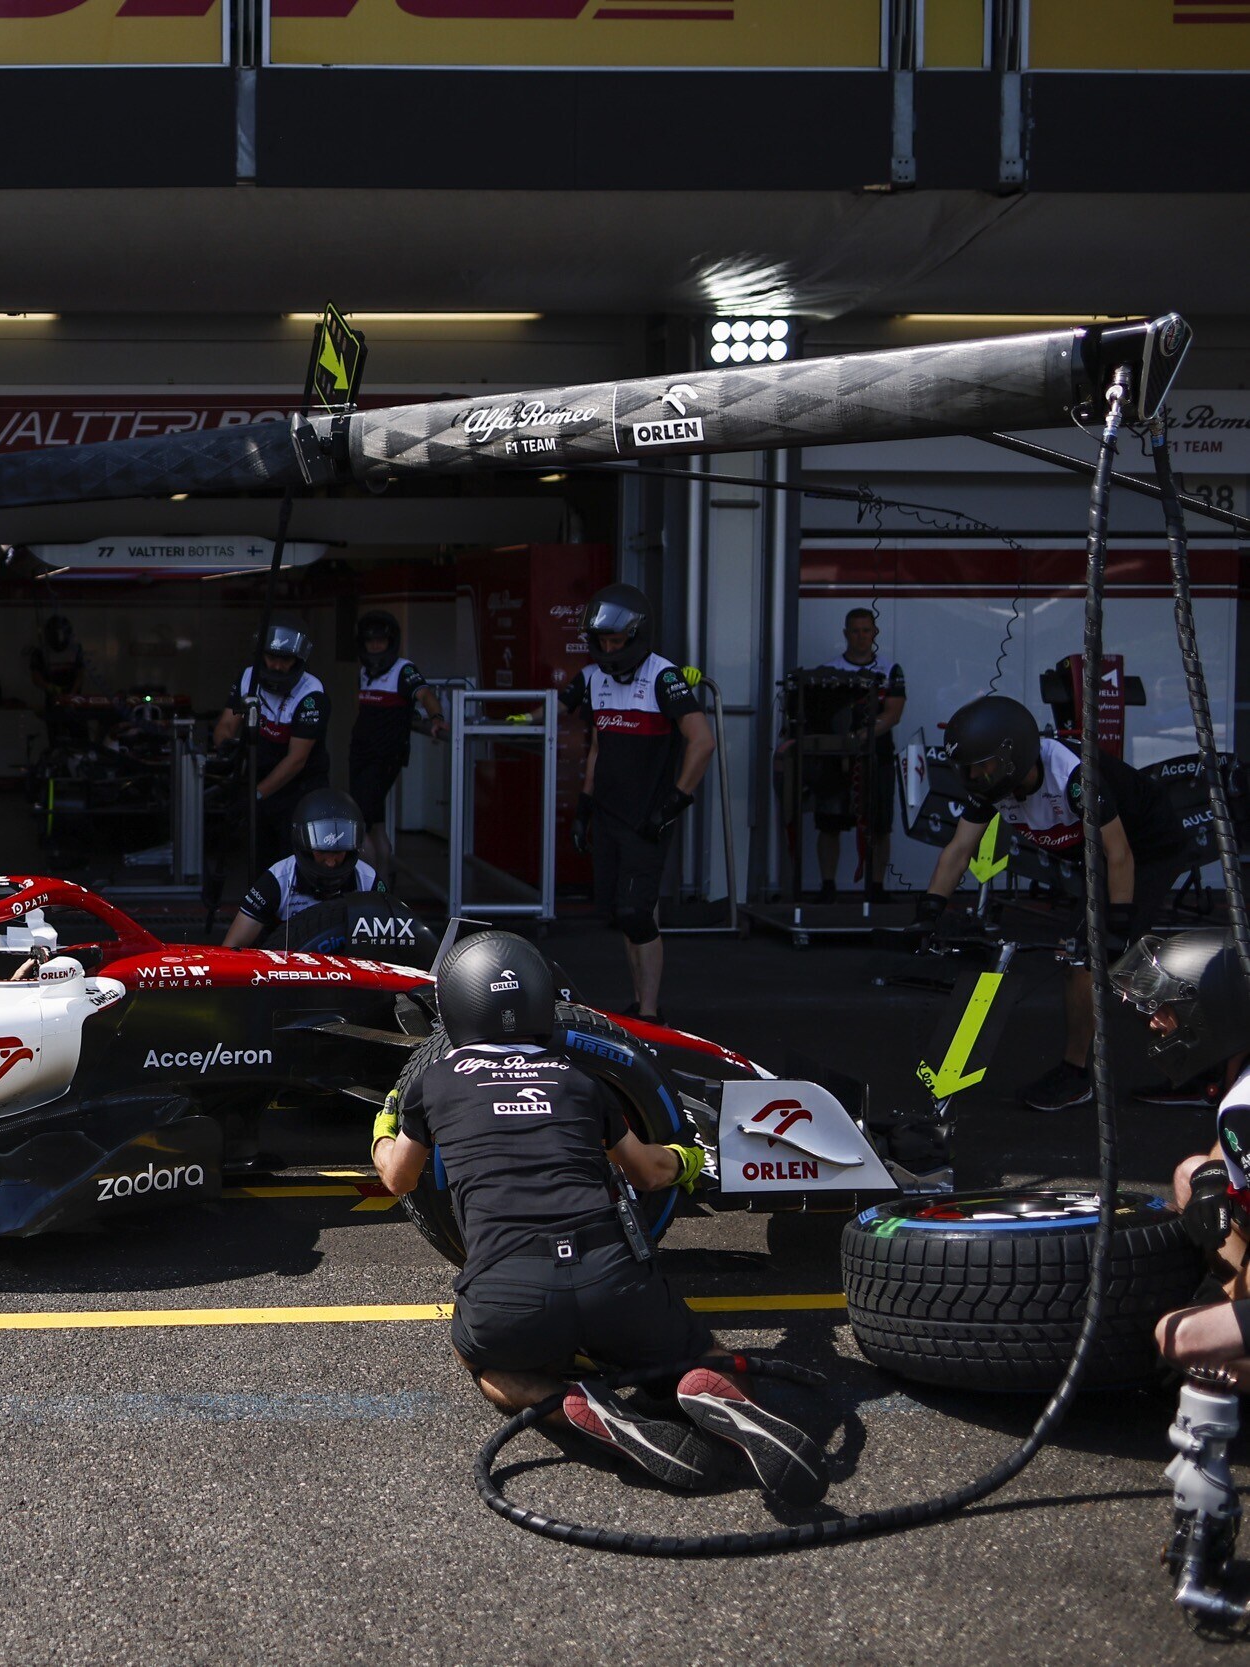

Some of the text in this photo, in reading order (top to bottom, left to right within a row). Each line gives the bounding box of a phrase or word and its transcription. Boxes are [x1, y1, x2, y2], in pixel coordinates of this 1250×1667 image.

[464, 400, 599, 443] Alfa Romeo
[635, 421, 699, 443] ORLEN
[505, 438, 556, 454] F1 TEAM
[1184, 441, 1222, 453] TEAM
[98, 546, 235, 558] 77 VALTTERI BOTTAS
[597, 714, 640, 730] Alfa Romeo
[25, 893, 49, 909] PATH
[352, 917, 415, 938] AMX
[41, 972, 69, 980] ORLEN
[137, 966, 186, 978] WEB
[139, 979, 212, 988] EYEWEAR
[492, 982, 517, 991] ORLEN
[566, 1029, 634, 1067] PIRELLI
[454, 1055, 570, 1075] Alfa Romeo
[496, 1103, 549, 1113] ORLEN
[742, 1161, 819, 1180] ORLEN
[97, 1163, 204, 1201] zadara
